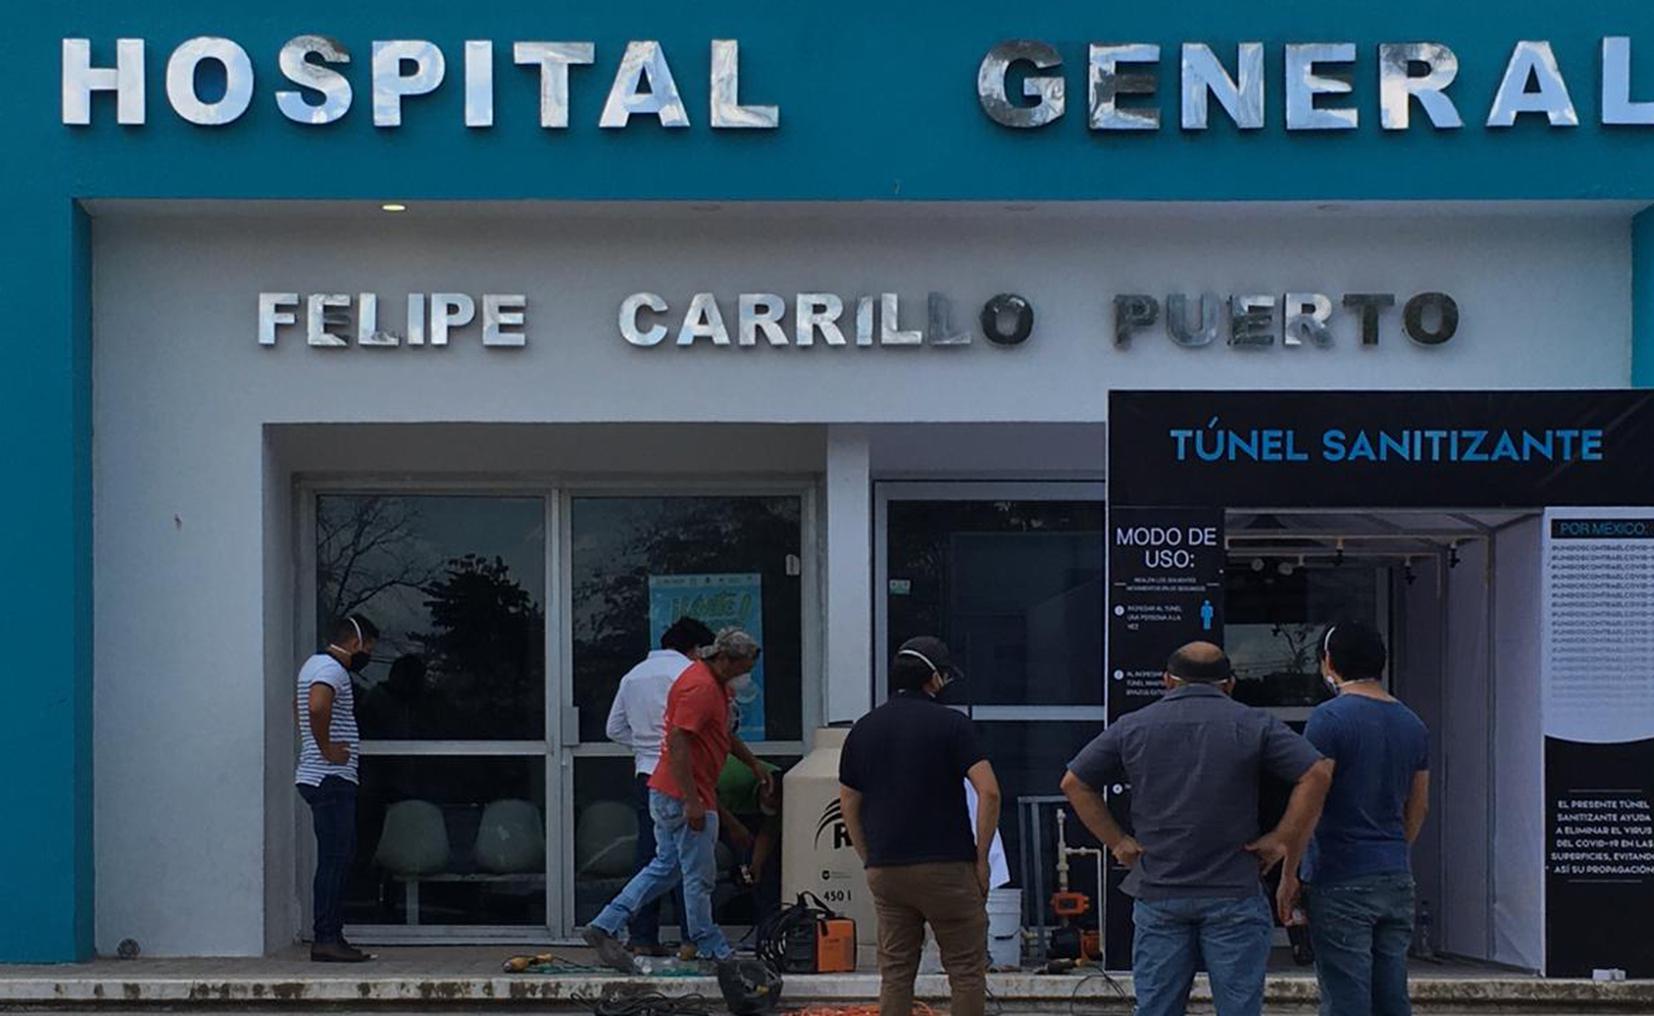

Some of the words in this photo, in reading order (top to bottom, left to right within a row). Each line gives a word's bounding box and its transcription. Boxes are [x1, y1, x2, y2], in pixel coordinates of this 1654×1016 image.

[61, 35, 780, 129] HOSPITAL
[977, 36, 1654, 131] GENERAL
[258, 293, 526, 347] FELIPE
[619, 293, 1035, 347] CARRILLO
[1113, 293, 1460, 347] PUERTO
[1170, 416, 1309, 461] TÚNEL
[1323, 429, 1603, 461] SANITIZANTE
[1560, 522, 1589, 535] POR
[1116, 527, 1182, 546] MODO
[1188, 527, 1217, 546] DE
[1145, 549, 1195, 568] USO:
[1558, 800, 1569, 809] EL
[1571, 800, 1617, 809] PRESENTE
[1557, 813, 1617, 822] SANITIZANTE
[1620, 813, 1652, 822] AYUDA
[1555, 826, 1563, 835] A
[1564, 826, 1609, 835] ELIMINAR
[1611, 826, 1622, 835] EL
[1556, 839, 1574, 848] DEL
[1575, 839, 1619, 848] COVID-19
[1621, 839, 1634, 848] EN
[1635, 839, 1654, 848] LAS
[1571, 865, 1585, 874] SU
[824, 890, 844, 902] 450
